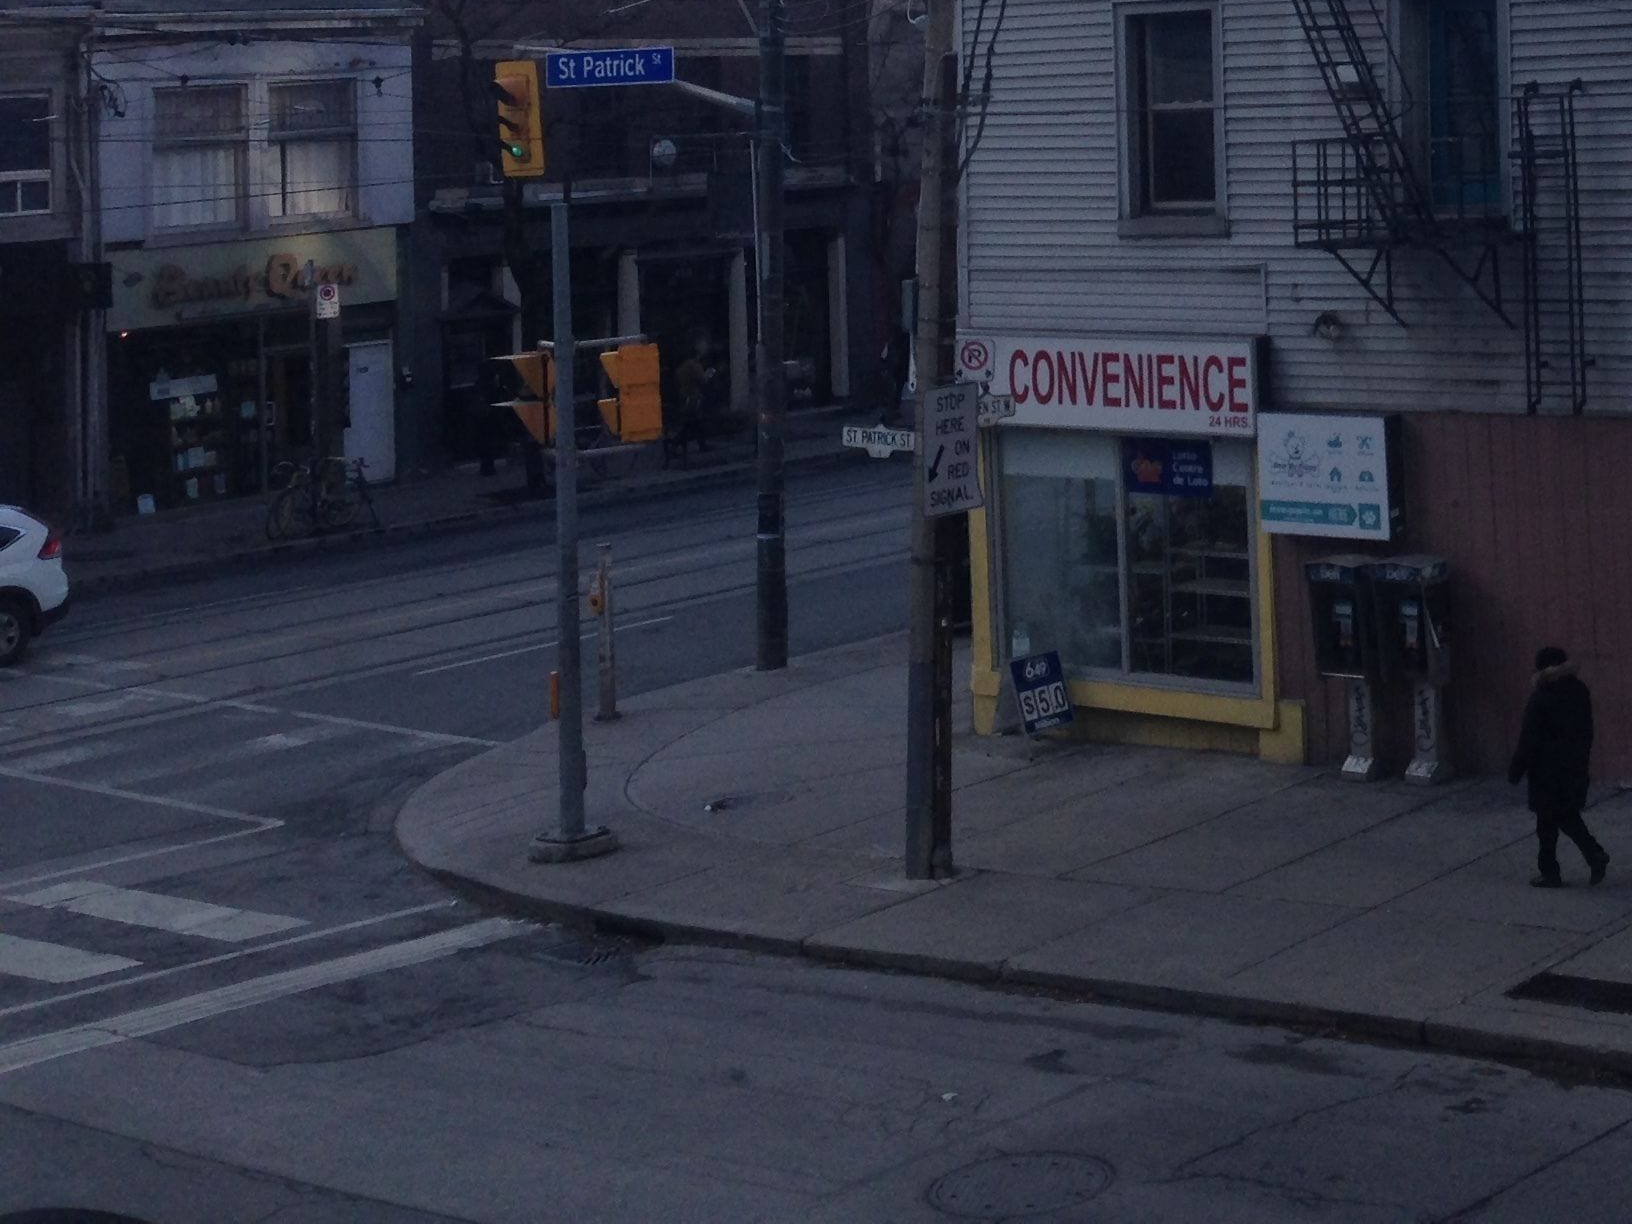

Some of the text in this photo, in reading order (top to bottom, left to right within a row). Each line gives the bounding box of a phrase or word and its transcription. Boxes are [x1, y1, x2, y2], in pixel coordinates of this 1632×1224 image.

[558, 53, 662, 80] St Patrick St
[1008, 348, 1249, 414] CONVENIENCE
[936, 393, 965, 412] STOP
[935, 416, 965, 435] HERE
[1208, 415, 1223, 428] 24
[861, 432, 898, 447] PATRICK
[900, 434, 912, 447] ST
[954, 439, 970, 457] ON
[947, 462, 970, 480] RED
